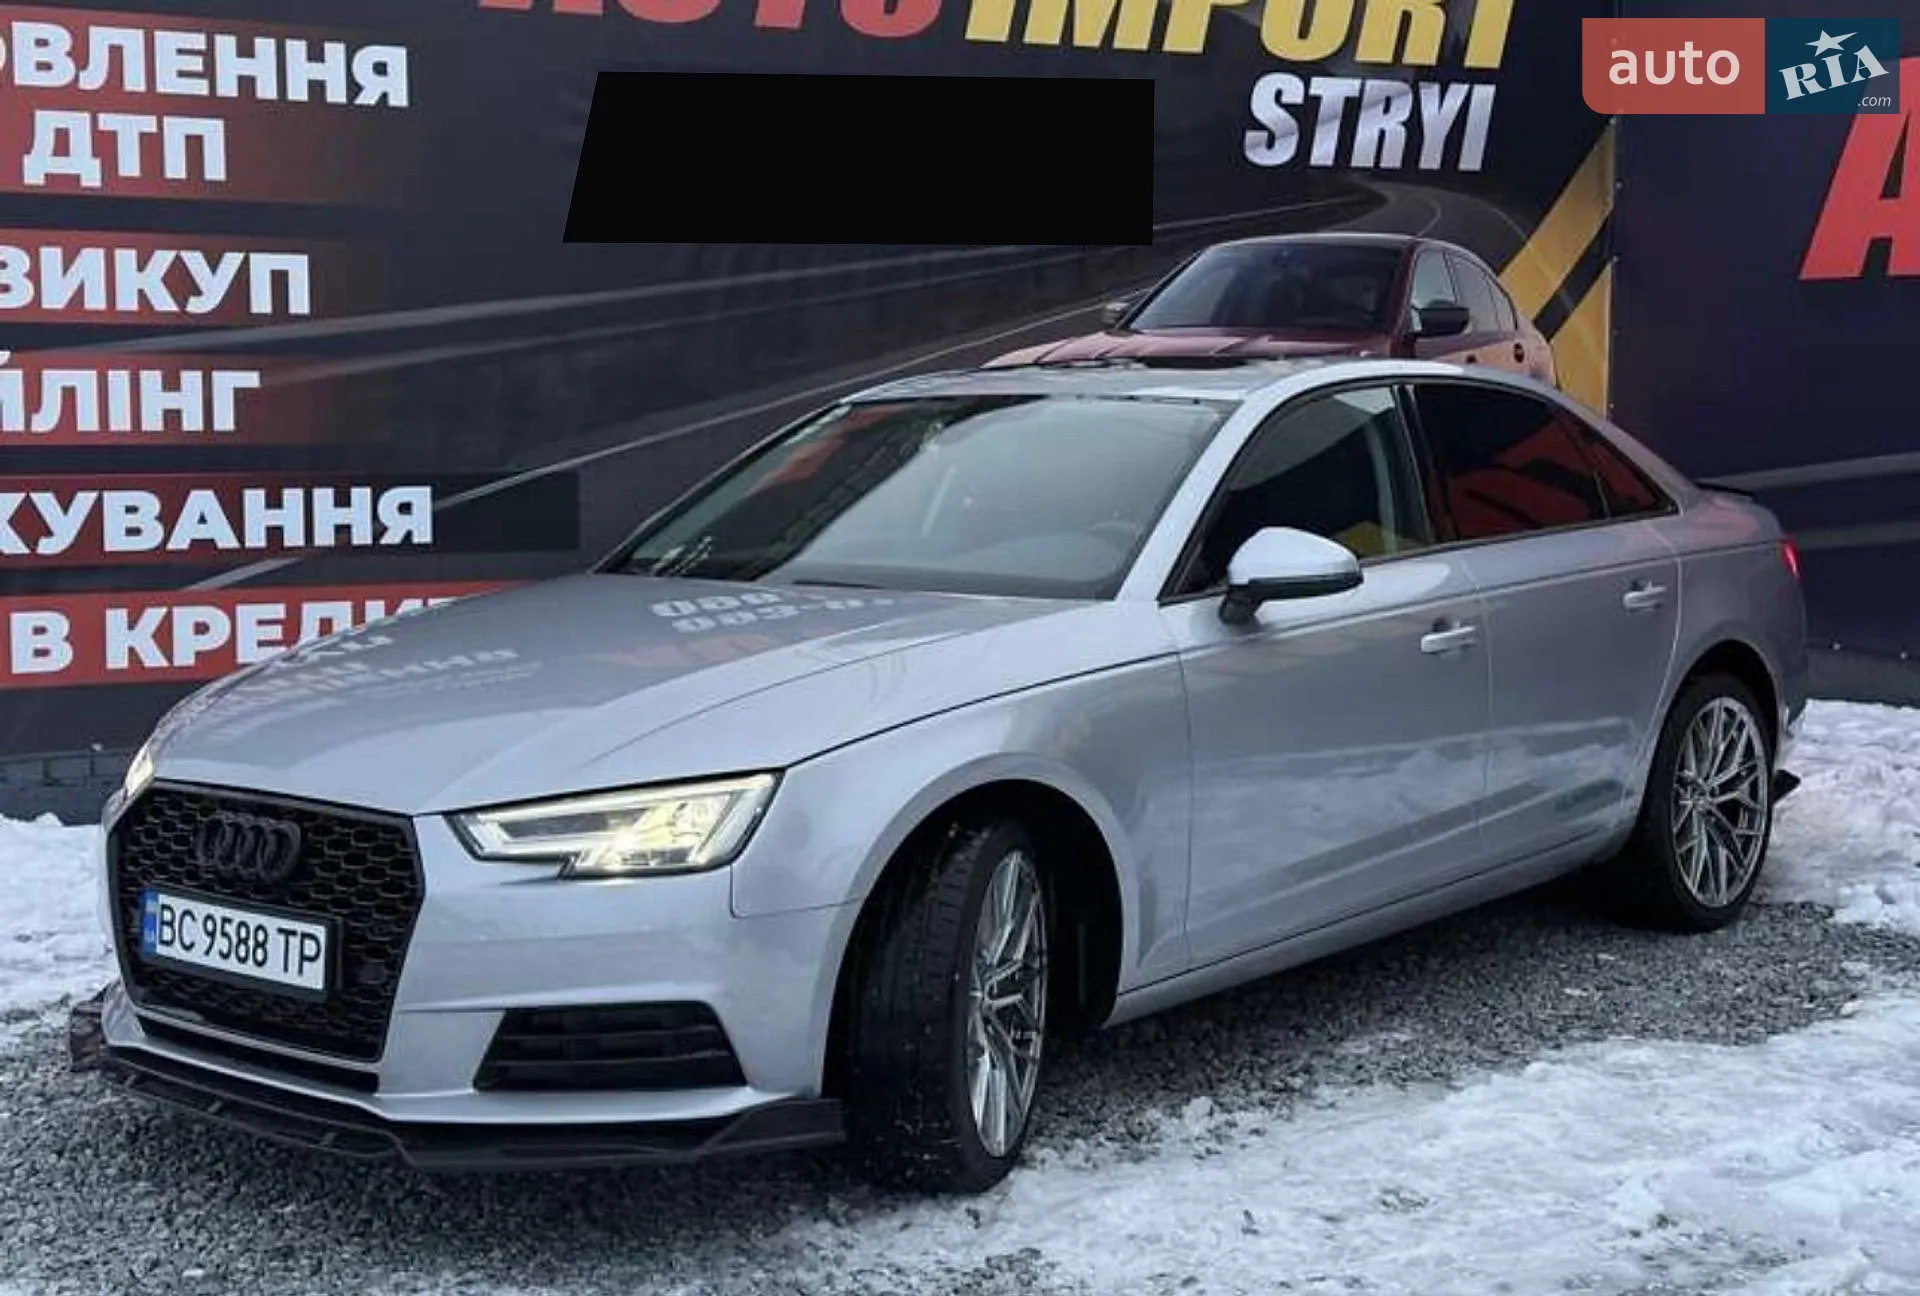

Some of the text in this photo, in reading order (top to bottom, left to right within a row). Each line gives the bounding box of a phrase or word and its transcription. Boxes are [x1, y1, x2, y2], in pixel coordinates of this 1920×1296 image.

[0, 20, 409, 107] ВЛЕННЯ
[22, 109, 227, 188] ДТП
[1244, 73, 1497, 170] STRYI
[0, 244, 311, 315] ВИКУП
[10, 610, 74, 674] В
[105, 598, 456, 670] КРЕ
[158, 904, 321, 976] BC 9588 TP
